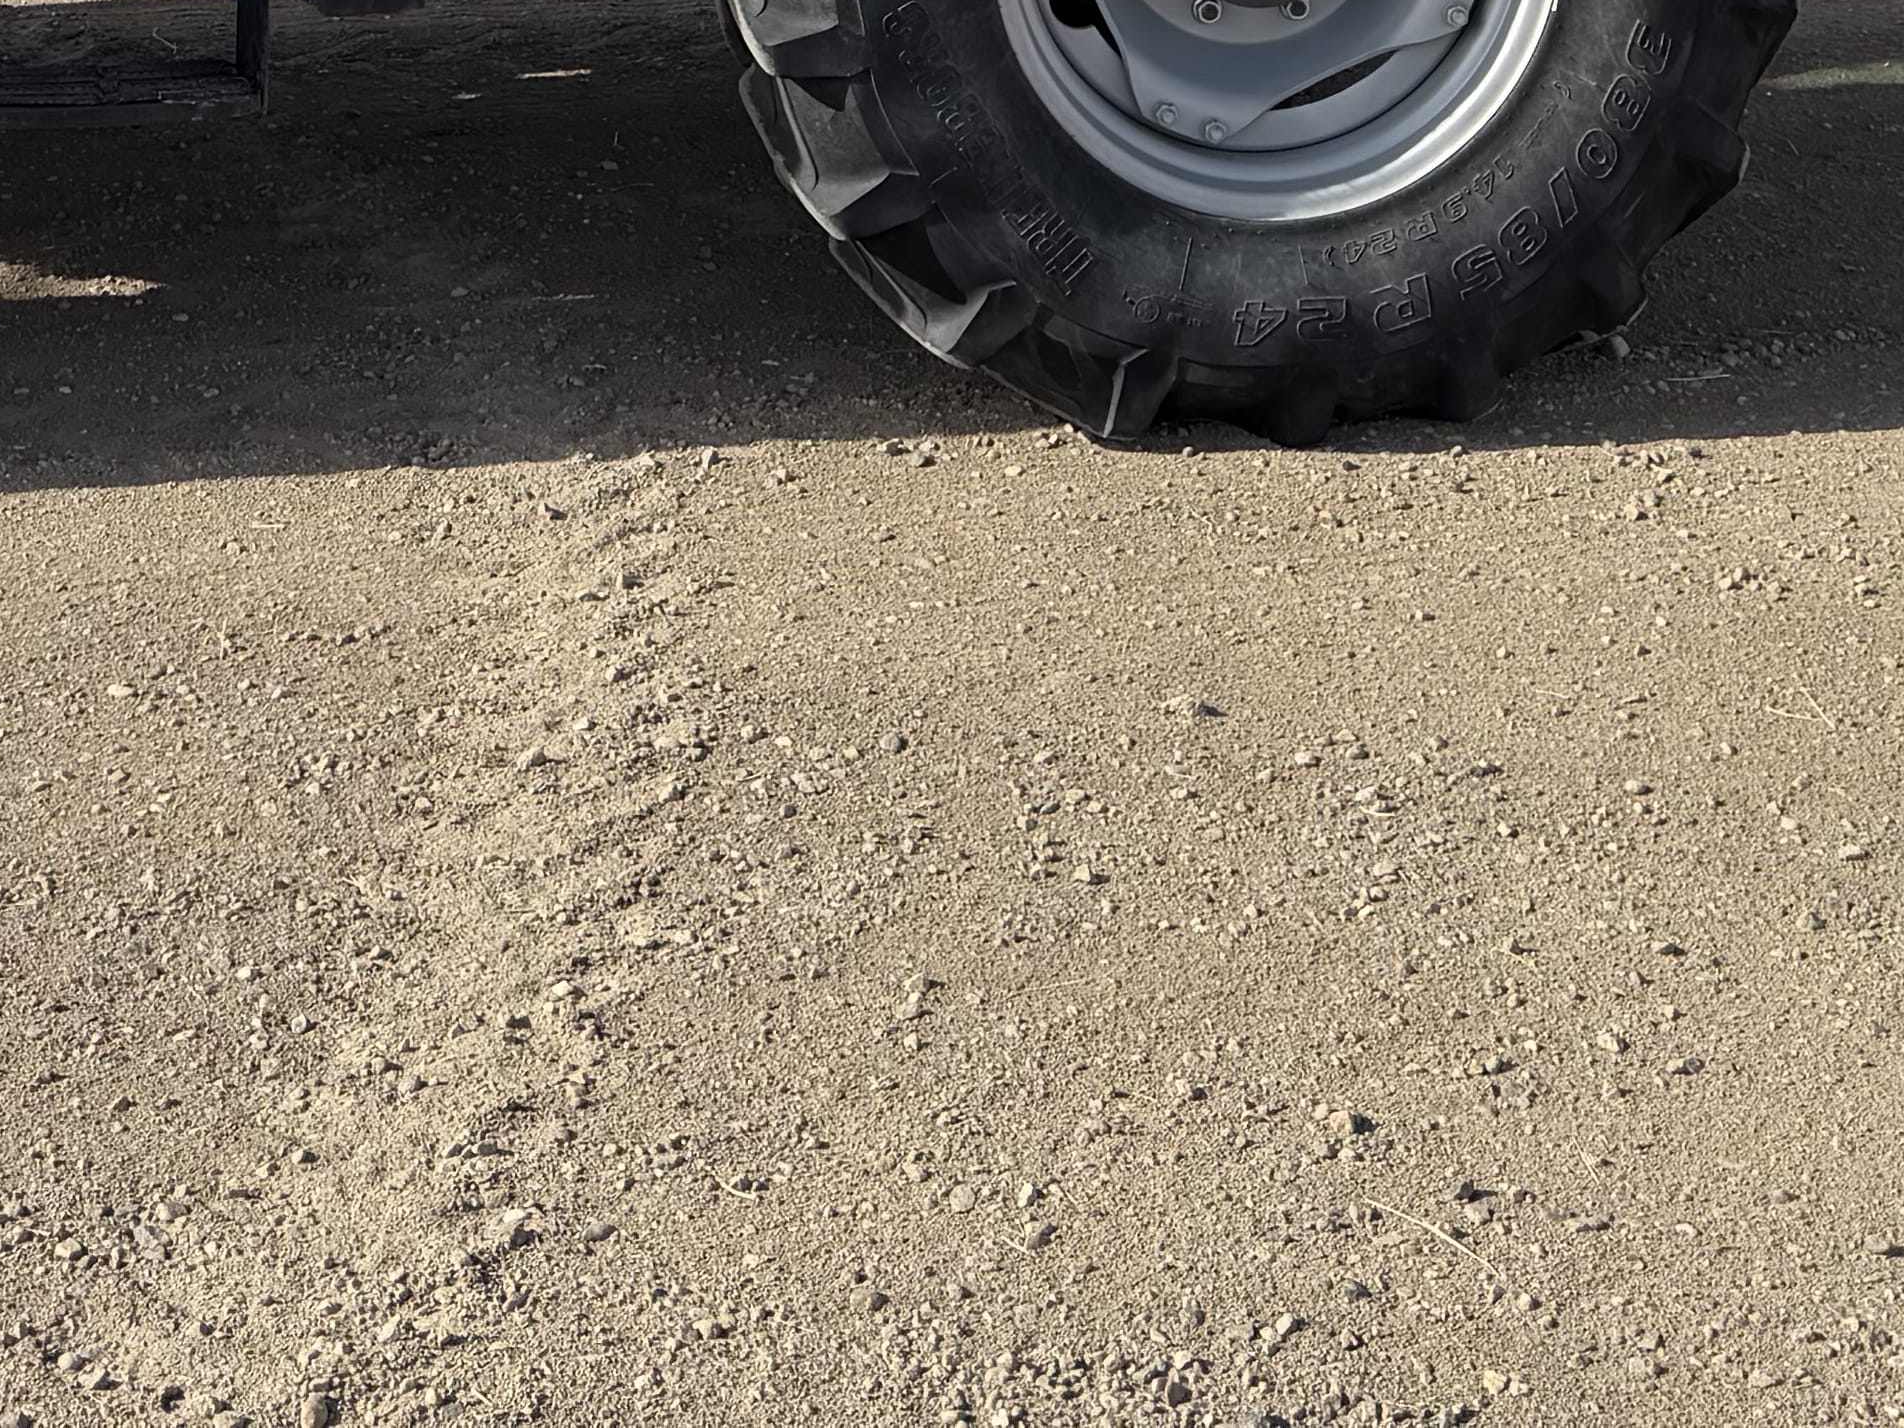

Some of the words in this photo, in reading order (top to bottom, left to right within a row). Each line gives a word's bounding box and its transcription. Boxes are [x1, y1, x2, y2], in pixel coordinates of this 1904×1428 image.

[1450, 17, 1674, 303] 380/85
[1402, 213, 1440, 242] R
[1231, 295, 1348, 348] 24
[1371, 272, 1434, 336] R
